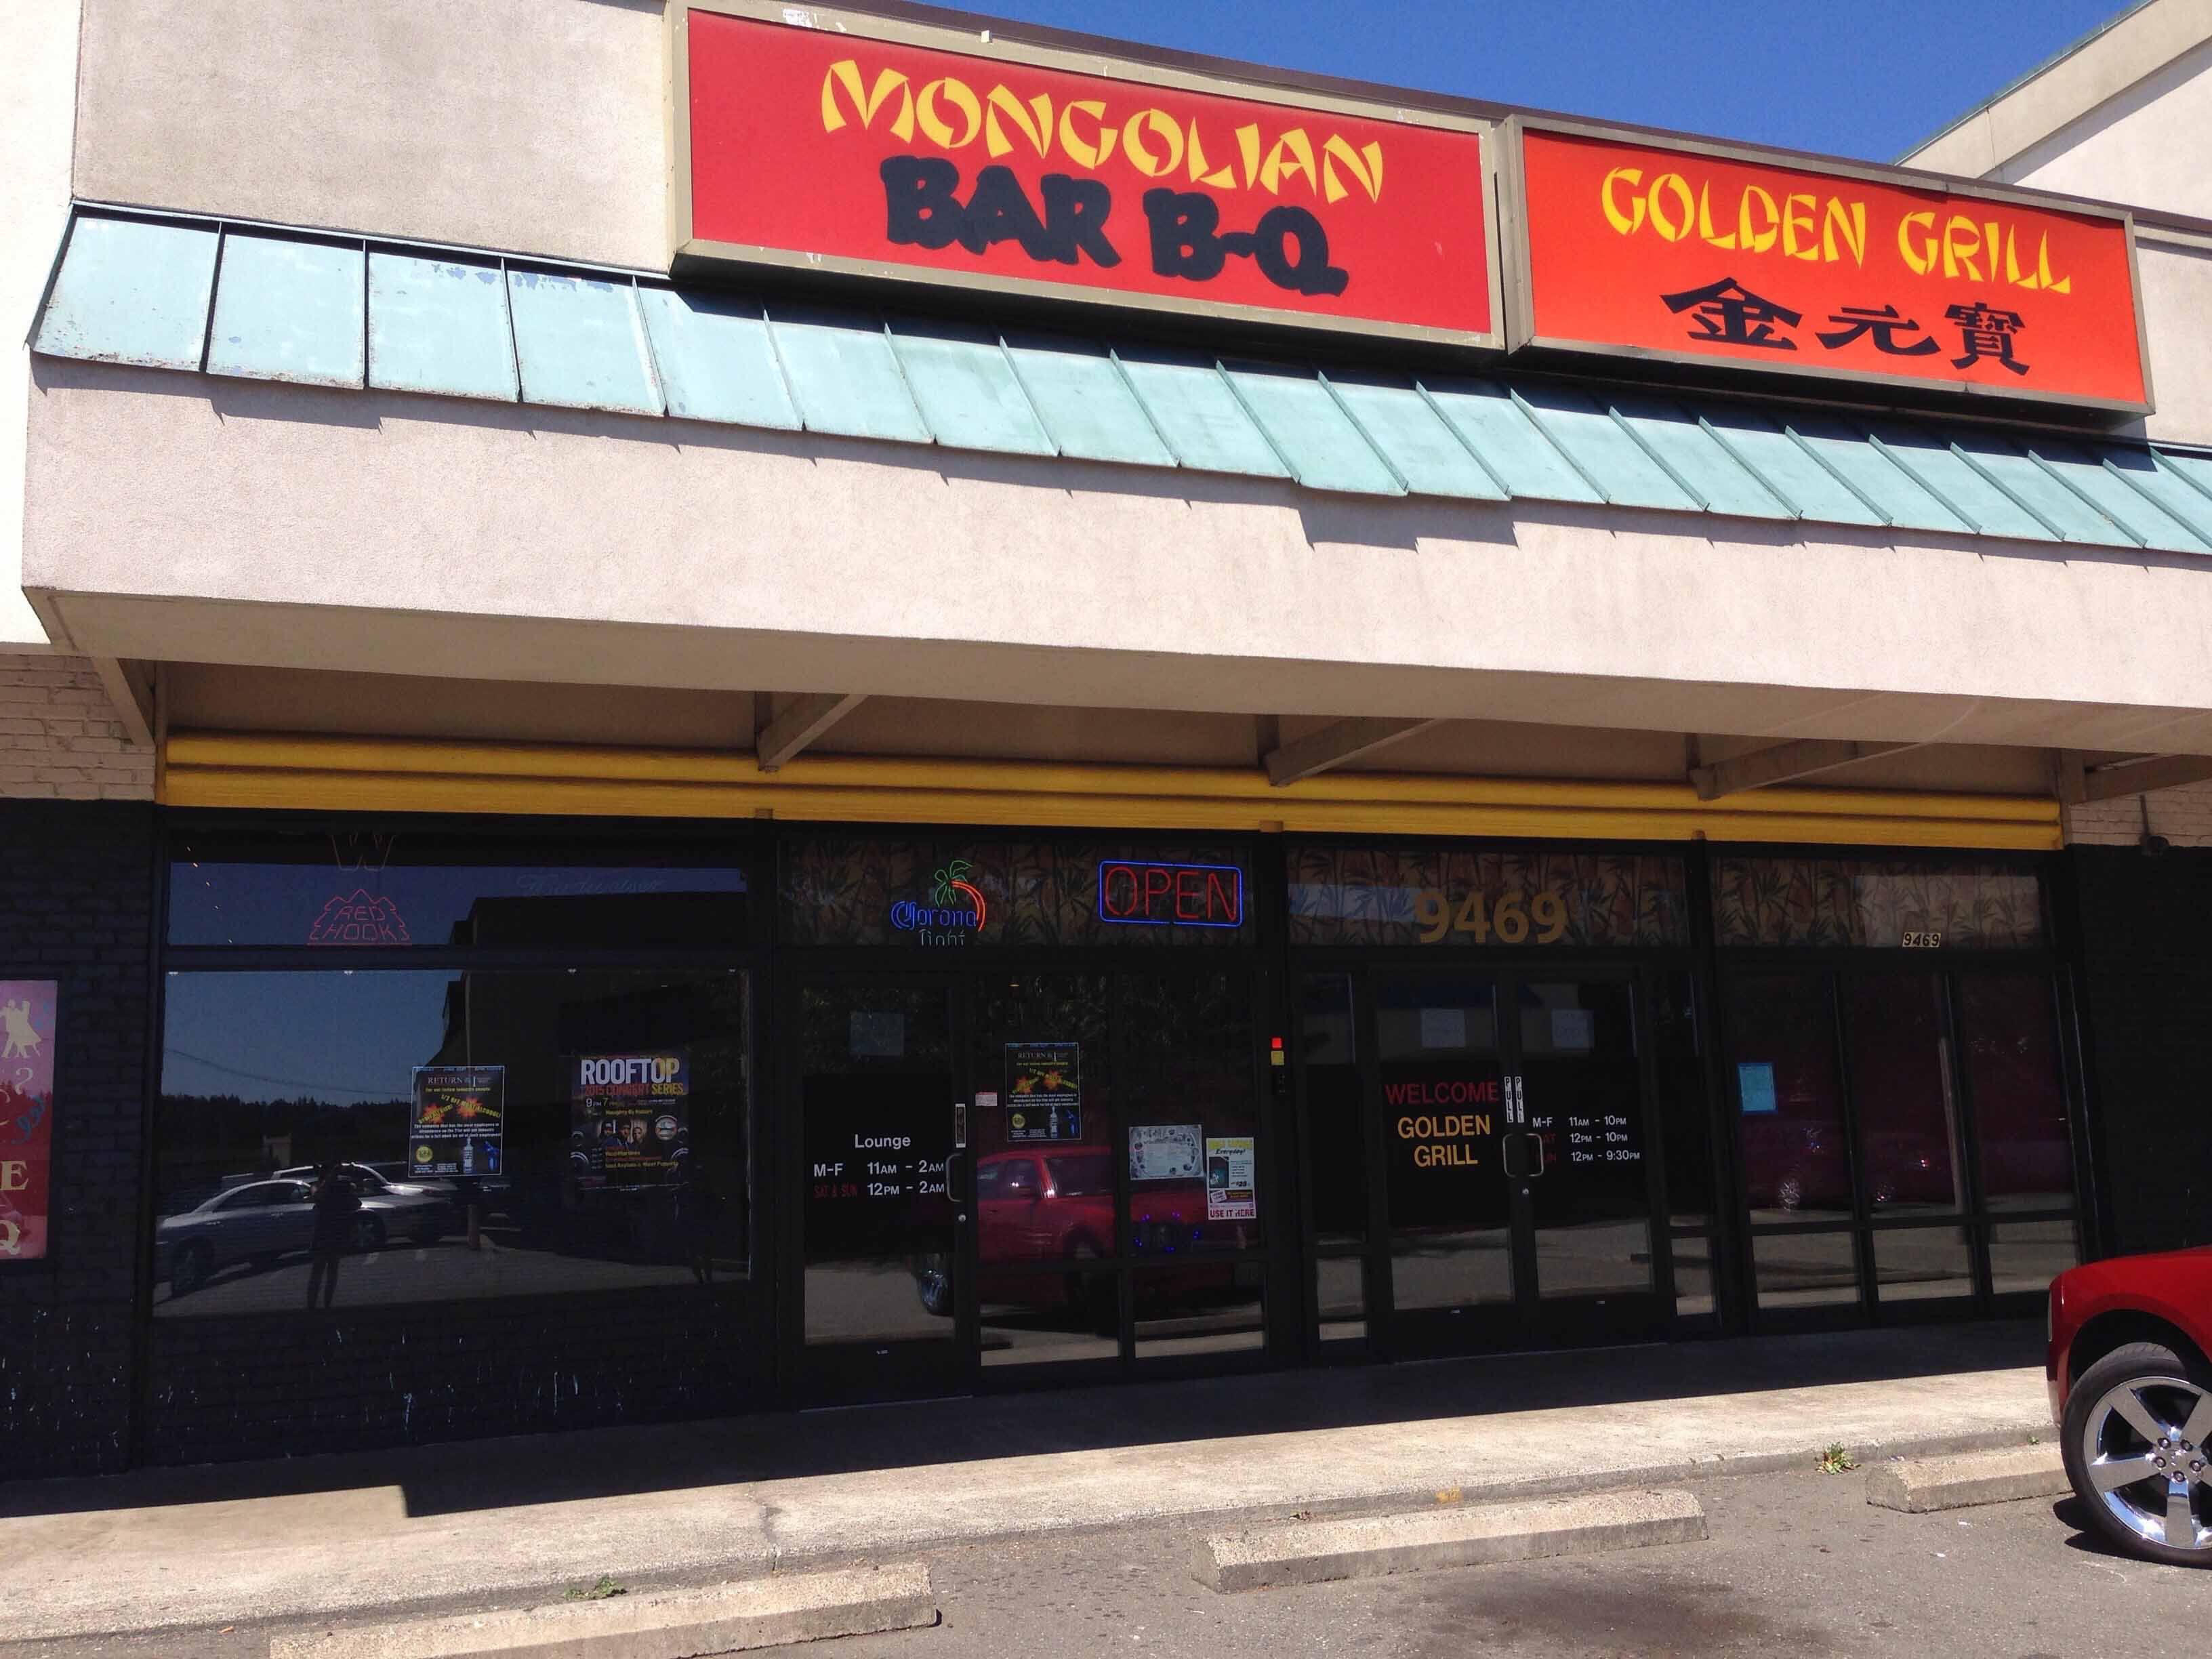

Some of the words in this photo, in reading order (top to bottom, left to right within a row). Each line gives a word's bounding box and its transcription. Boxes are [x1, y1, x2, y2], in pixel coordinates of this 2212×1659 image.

[821, 59, 1383, 204] MONGOLIAN
[880, 155, 1122, 270] BAR
[1143, 187, 1349, 298] B-Q
[1601, 167, 1866, 270] GOLDEN
[1898, 211, 2071, 295] GRILL
[1660, 276, 2029, 377] 金元寶
[1105, 865, 1237, 922] OPEN
[333, 905, 386, 922] RED
[890, 899, 977, 930] Corona
[1414, 890, 1568, 944] 9469
[321, 922, 397, 941] HOOK
[1904, 933, 1940, 947] 9469
[428, 1076, 463, 1085] RETURN
[581, 1057, 680, 1086] ROOFTOP
[651, 1083, 684, 1095] SERIES
[1385, 1081, 1500, 1105] WELCOME
[1504, 1077, 1513, 1123] PULL
[1397, 1113, 1492, 1139] GOLDEN
[1532, 1116, 1553, 1128] M-F
[1568, 1116, 1590, 1127] 11AM
[1604, 1115, 1627, 1126] 10PM
[854, 1133, 912, 1150] Lounge
[1570, 1132, 1593, 1143] 12PM
[1605, 1131, 1628, 1142] 10PM
[1413, 1144, 1480, 1168] GRILL
[1571, 1151, 1594, 1162] 12PM
[1606, 1149, 1641, 1161] 9:30PM
[813, 1162, 844, 1177] M-F
[867, 1161, 897, 1175] 11AM
[918, 1160, 945, 1173] 2AM
[867, 1182, 900, 1196] 12PM
[919, 1180, 945, 1193] 2AM
[1210, 1209, 1224, 1218] USE
[1226, 1209, 1233, 1217] IT
